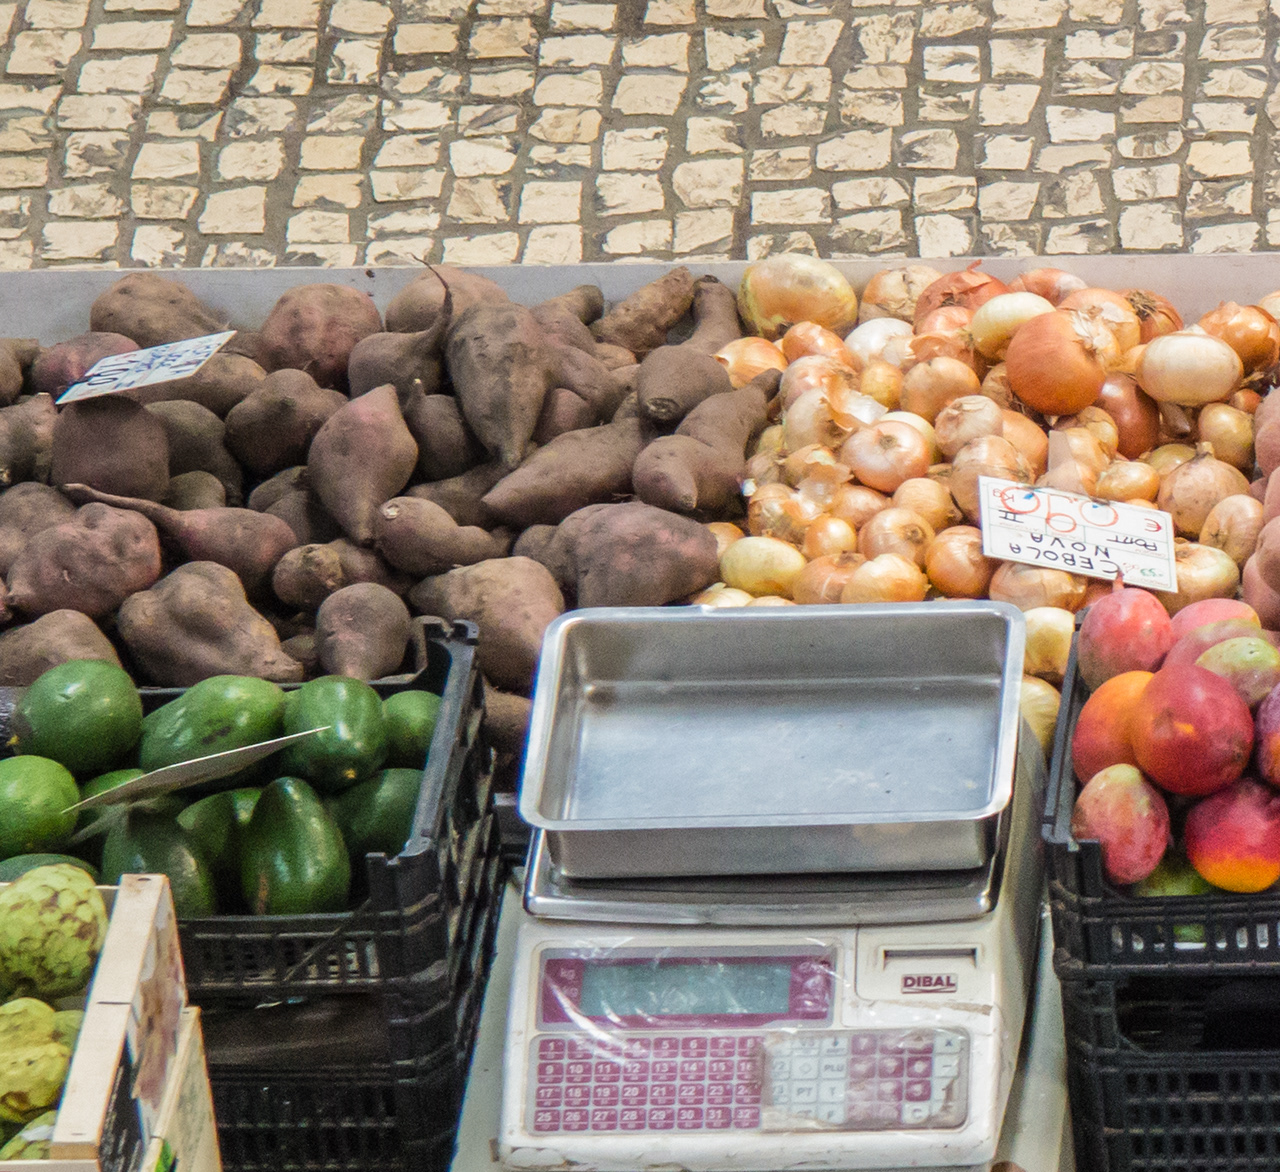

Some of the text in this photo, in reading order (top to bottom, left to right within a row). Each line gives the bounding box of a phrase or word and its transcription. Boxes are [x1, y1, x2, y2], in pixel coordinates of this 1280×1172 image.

[1030, 532, 1111, 560] NOVA
[1009, 542, 1120, 575] CEBOLA
[902, 975, 957, 988] DIBAL
[569, 1064, 584, 1074] 10
[598, 1064, 611, 1074] 11
[626, 1063, 640, 1073] 12
[655, 1063, 668, 1072] 13
[683, 1062, 698, 1072] 14
[712, 1062, 726, 1072] 15
[539, 1088, 554, 1098] 17
[568, 1088, 582, 1098] 18
[596, 1087, 610, 1097] 19
[624, 1086, 640, 1096] 20
[652, 1086, 666, 1096] 21
[680, 1086, 696, 1096] 22
[709, 1086, 724, 1096] 23
[537, 1109, 750, 1122] 25 26 27 28 29 30 31 32
